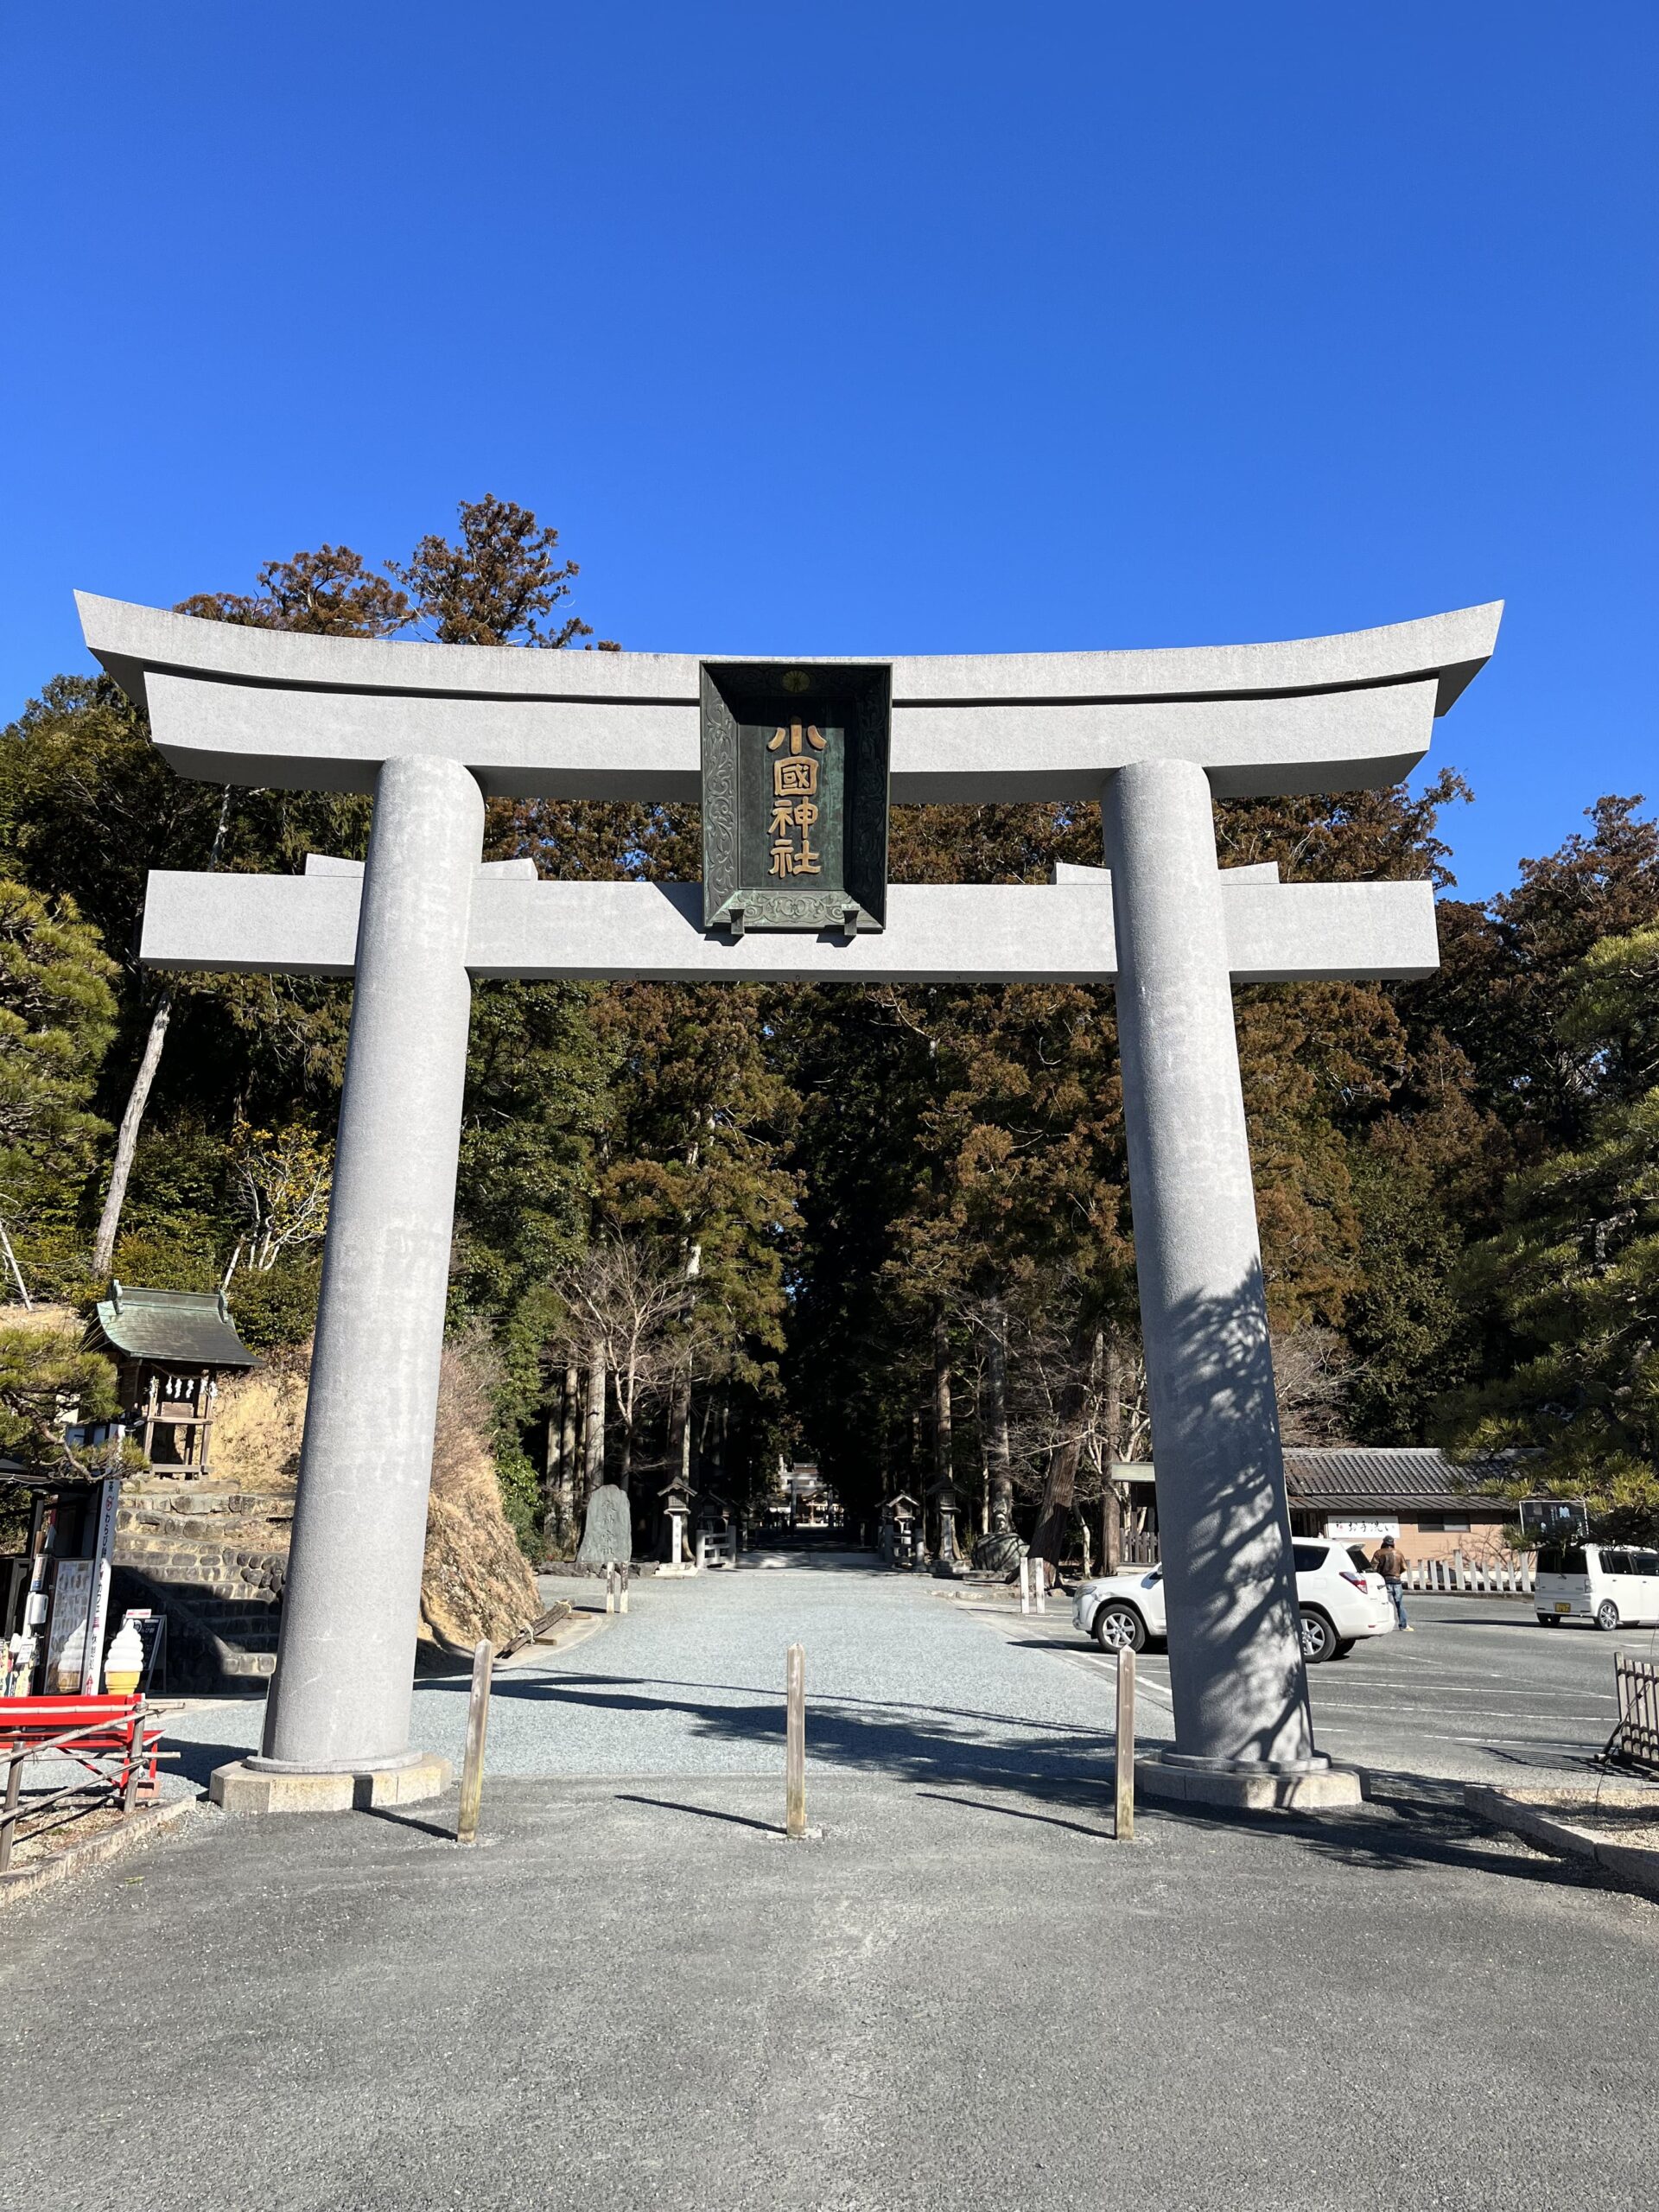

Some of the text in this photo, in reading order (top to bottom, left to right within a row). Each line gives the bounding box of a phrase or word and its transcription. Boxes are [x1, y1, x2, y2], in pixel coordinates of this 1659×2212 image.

[767, 715, 827, 879] 小國神社
[1349, 1521, 1395, 1532] お手洗い
